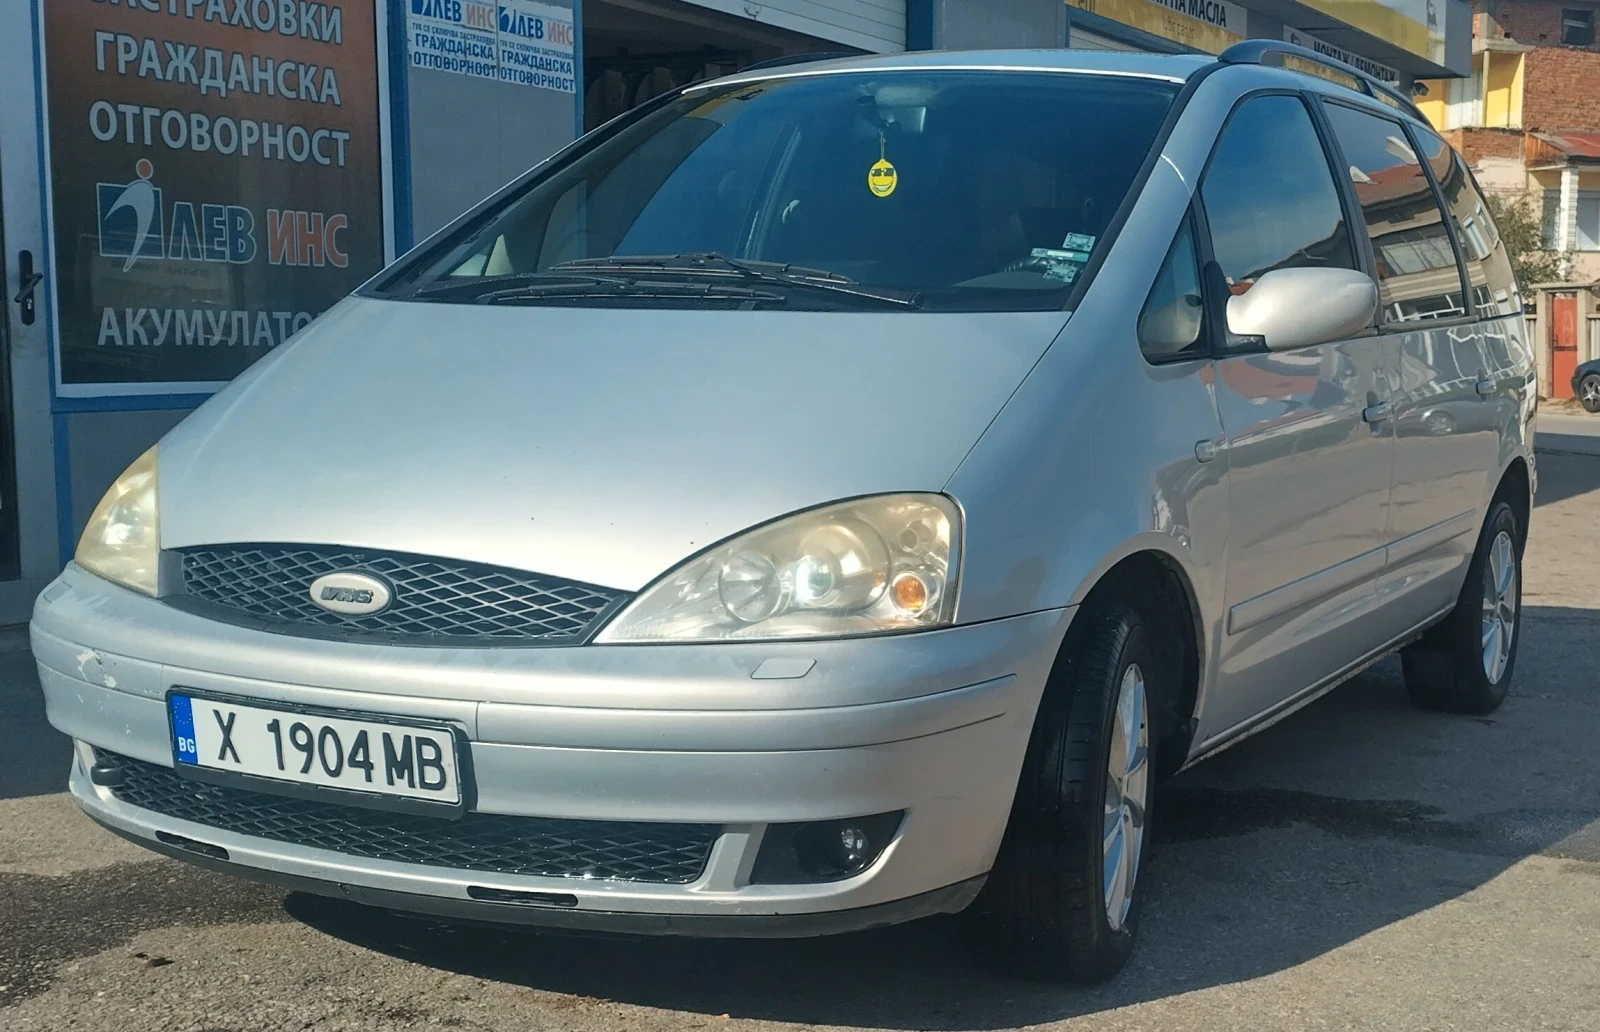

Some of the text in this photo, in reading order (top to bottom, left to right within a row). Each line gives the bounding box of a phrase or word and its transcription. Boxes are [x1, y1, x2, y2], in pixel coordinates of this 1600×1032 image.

[433, 0, 462, 22] ЛЕВ
[466, 3, 495, 29] ИНС
[1188, 0, 1227, 28] МАСЛА
[517, 15, 544, 40] ЛЕВ
[547, 21, 574, 46] ИНС
[415, 33, 494, 61] ГРАЖДАНСКА
[94, 30, 343, 106] ГРАЖДАНСКА
[413, 51, 497, 78] ОТГОВОРНОСТ
[501, 50, 573, 75] ГРАЖДАНСКА
[500, 66, 575, 92] ОТГОВОРНОСТ
[88, 100, 350, 167] ОТГОВОРНОСТ
[168, 201, 349, 268] ЛЕВ ИНС
[97, 307, 321, 347] АКУМУЛАТО
[178, 736, 195, 754] BG
[212, 708, 242, 764] X
